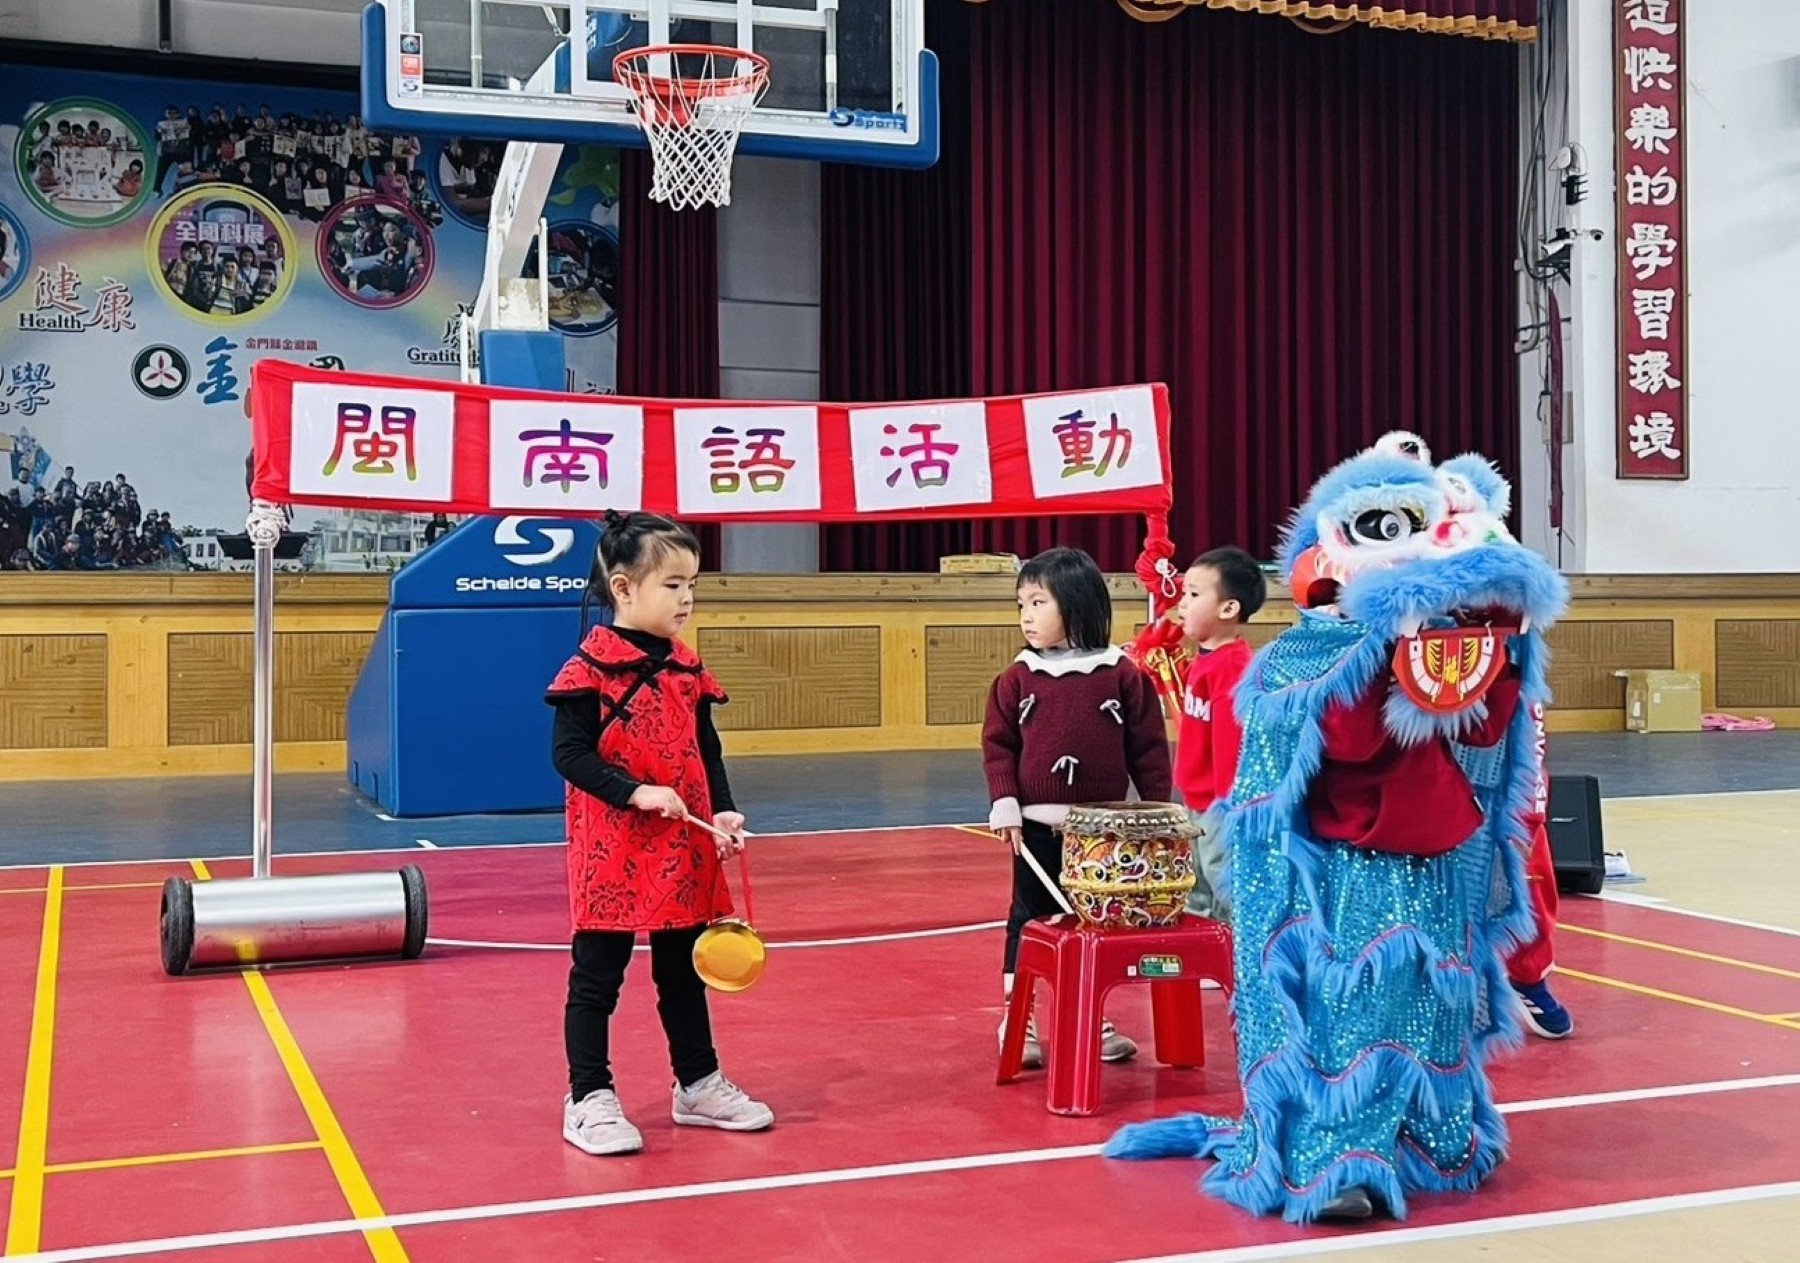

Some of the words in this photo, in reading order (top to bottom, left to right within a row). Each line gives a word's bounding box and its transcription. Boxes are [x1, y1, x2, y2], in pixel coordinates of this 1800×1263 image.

[175, 220, 265, 244] 全國科展
[19, 313, 82, 328] Health
[321, 402, 1133, 494] 閩南語活動
[545, 576, 589, 593] Spo
